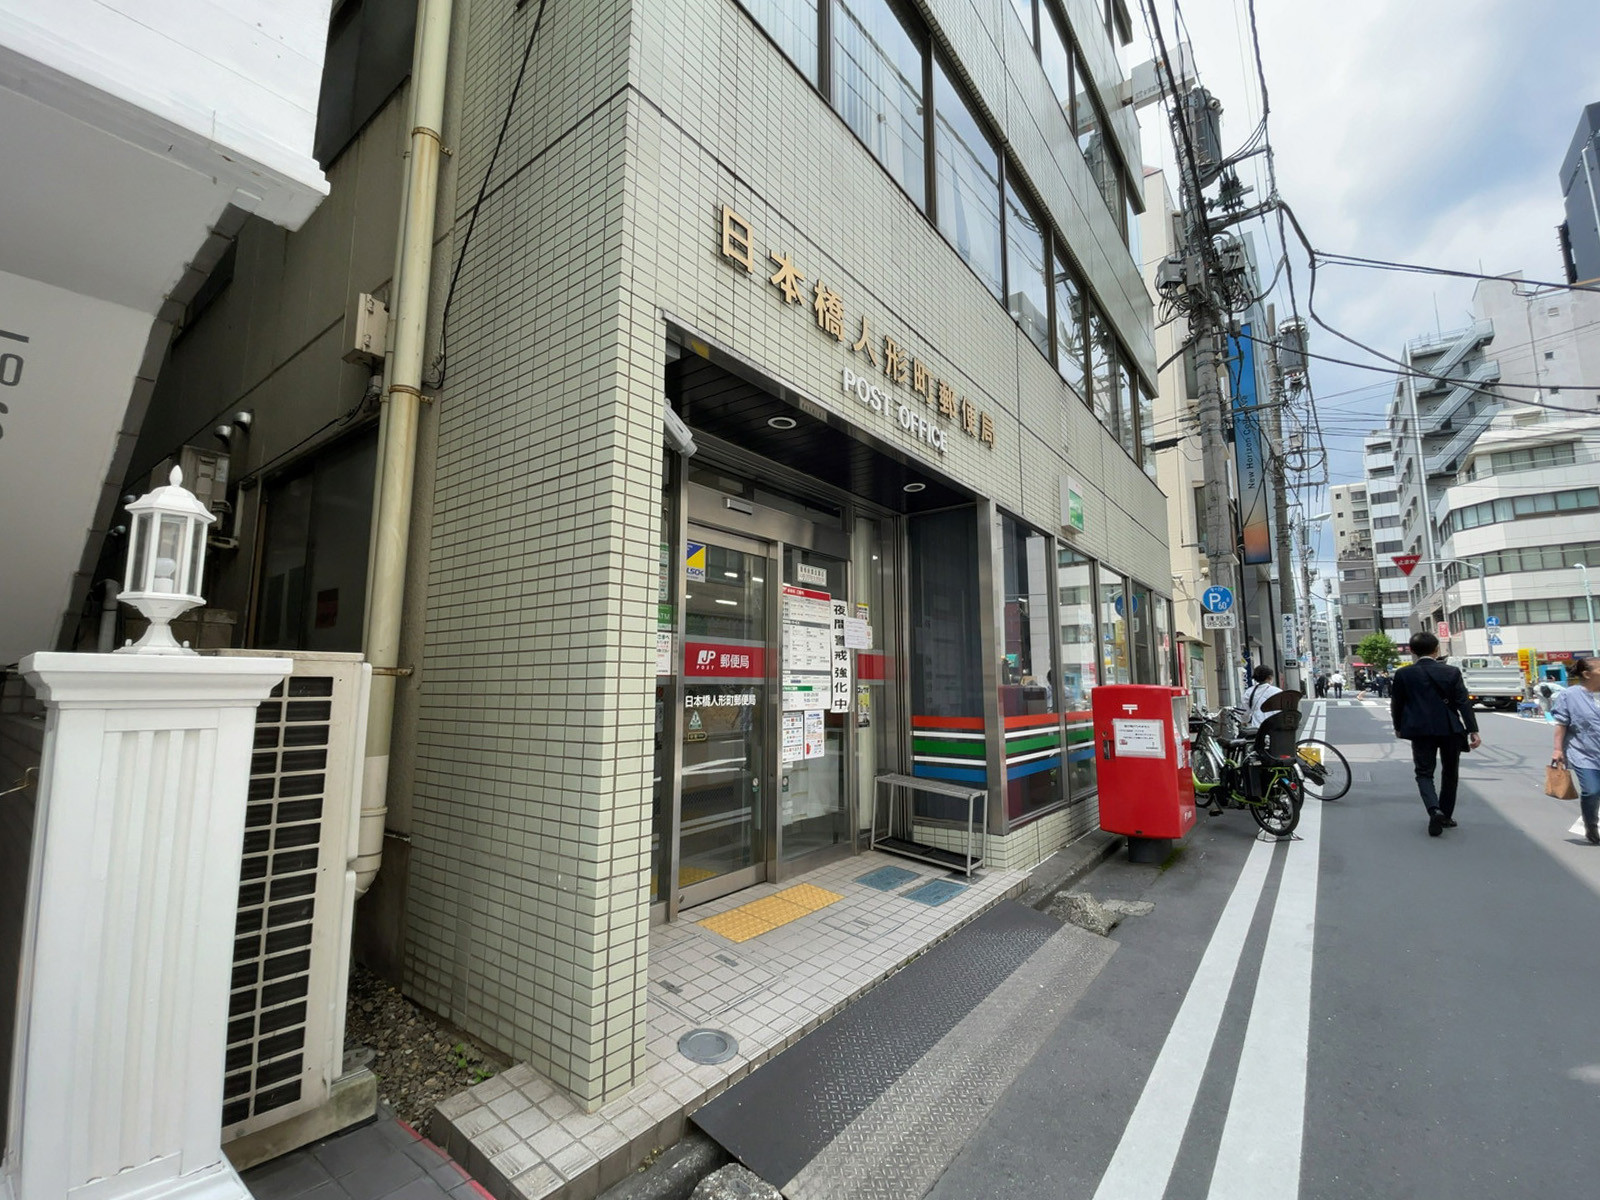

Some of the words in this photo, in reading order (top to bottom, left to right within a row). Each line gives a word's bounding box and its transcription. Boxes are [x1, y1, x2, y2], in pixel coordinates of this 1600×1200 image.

[721, 203, 997, 450] 日本橋人形町郵便局
[842, 366, 892, 417] POST
[897, 404, 949, 453] OFFICE
[1244, 437, 1255, 469] Horizon
[1247, 472, 1257, 490] New
[1208, 592, 1221, 610] P
[697, 649, 717, 664] JP
[719, 653, 750, 669] 郵便局
[833, 604, 848, 710] 夜間警戒強化中
[684, 694, 757, 708] 日本橋人形町郵便局
